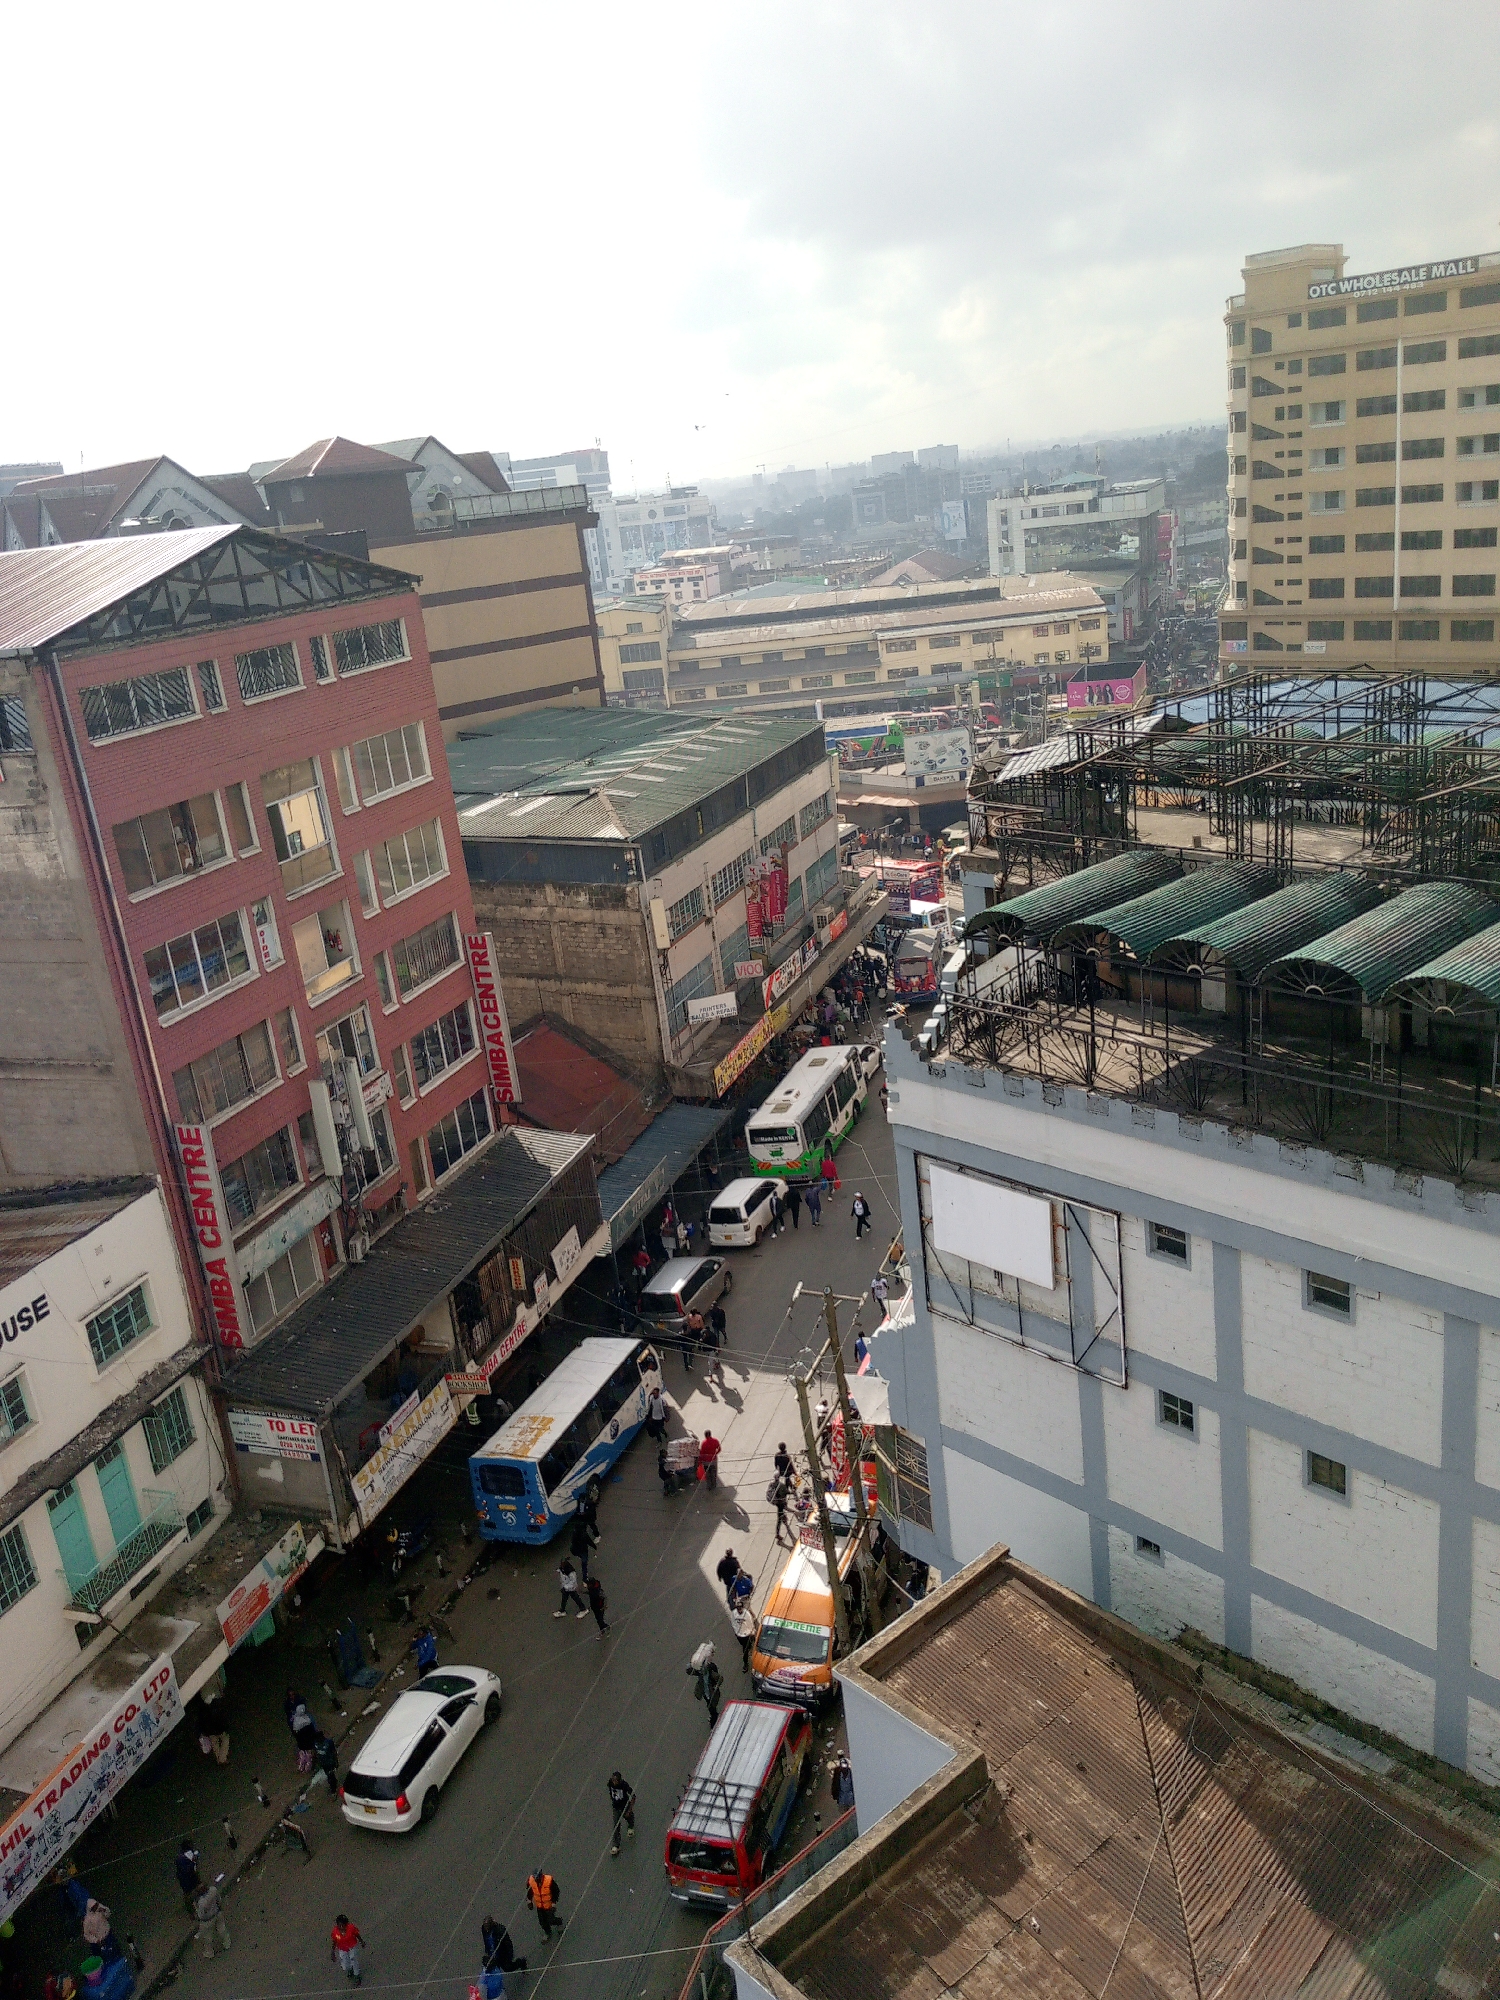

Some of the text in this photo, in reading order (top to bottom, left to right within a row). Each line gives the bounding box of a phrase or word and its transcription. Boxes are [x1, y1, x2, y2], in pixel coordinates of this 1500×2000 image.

[1309, 260, 1475, 299] OTC WHOLESALE MALL
[1353, 288, 1378, 298] 0712
[468, 935, 514, 1103] SIMBA CENTRE
[700, 1003, 727, 1013] PRINTERS
[178, 1126, 243, 1348] SIMBA CENTRE
[0, 1293, 50, 1349] USE
[481, 1319, 527, 1376] MBA CENTRE
[267, 1419, 286, 1432] TO
[290, 1422, 316, 1437] LET
[356, 1384, 445, 1489] SUPERIOR
[378, 1447, 401, 1476] SEWING
[774, 1619, 822, 1634] SUPREME
[0, 1823, 32, 1863] HIL
[34, 1732, 111, 1820] TRADING
[113, 1703, 141, 1734] CO.
[143, 1667, 170, 1702] LTD
